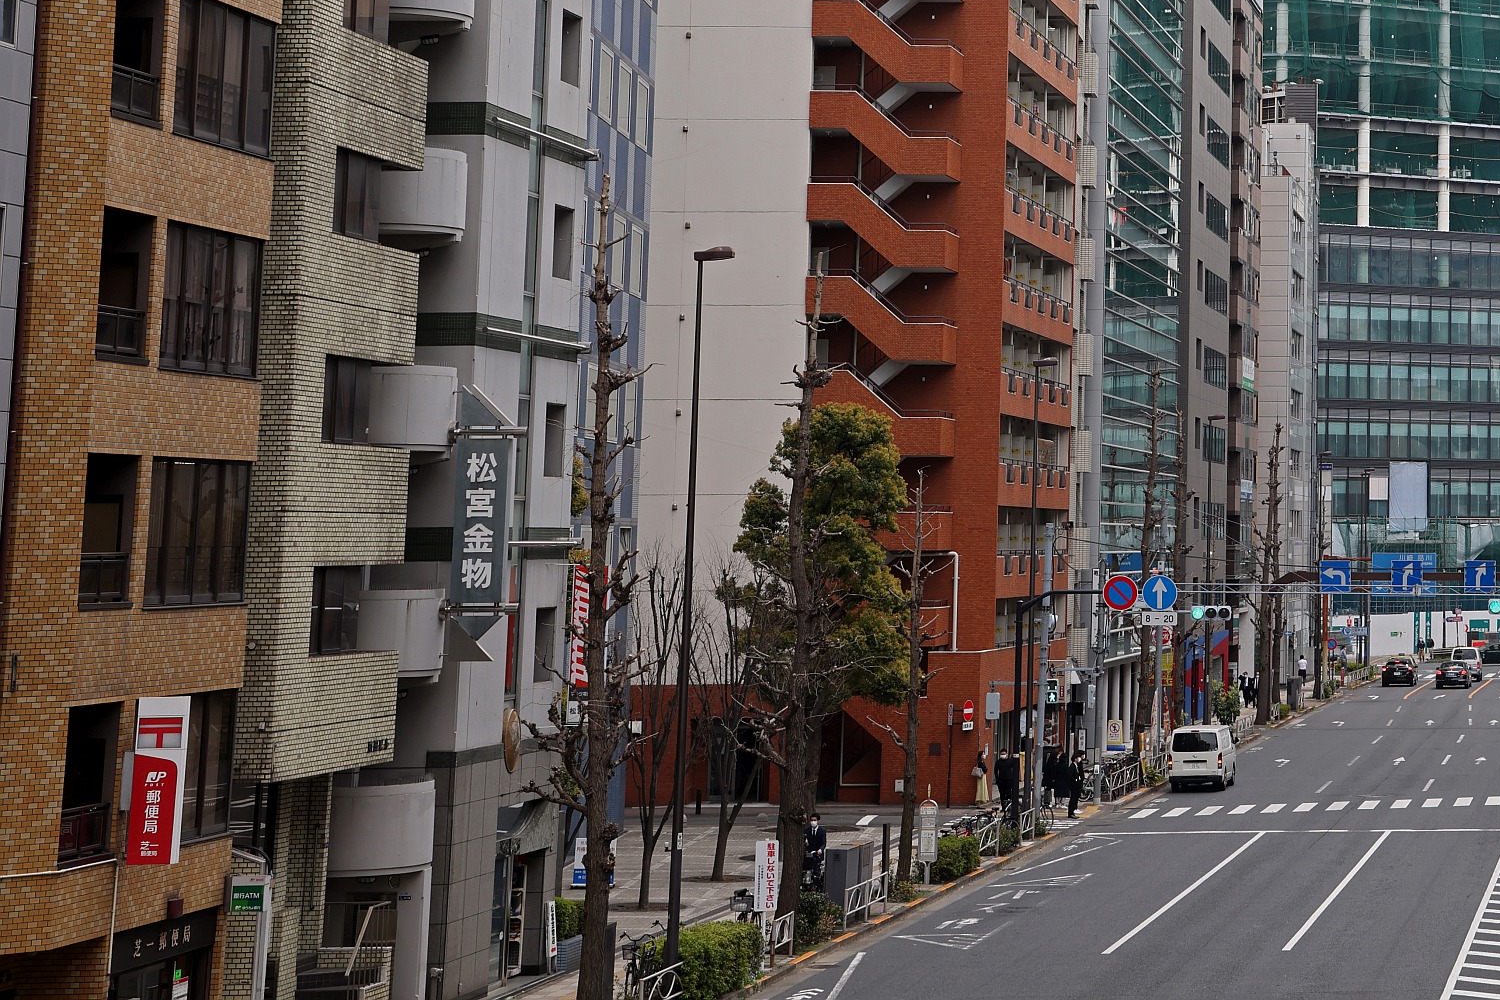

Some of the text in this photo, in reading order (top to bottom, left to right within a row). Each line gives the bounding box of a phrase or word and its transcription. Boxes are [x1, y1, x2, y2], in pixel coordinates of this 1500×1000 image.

[461, 452, 498, 589] 松宮金物
[143, 790, 161, 834] 郵便局
[140, 841, 159, 850] 芝一
[766, 843, 775, 909] 駐車しないで下さい
[133, 925, 191, 958] 芝一郵便局
